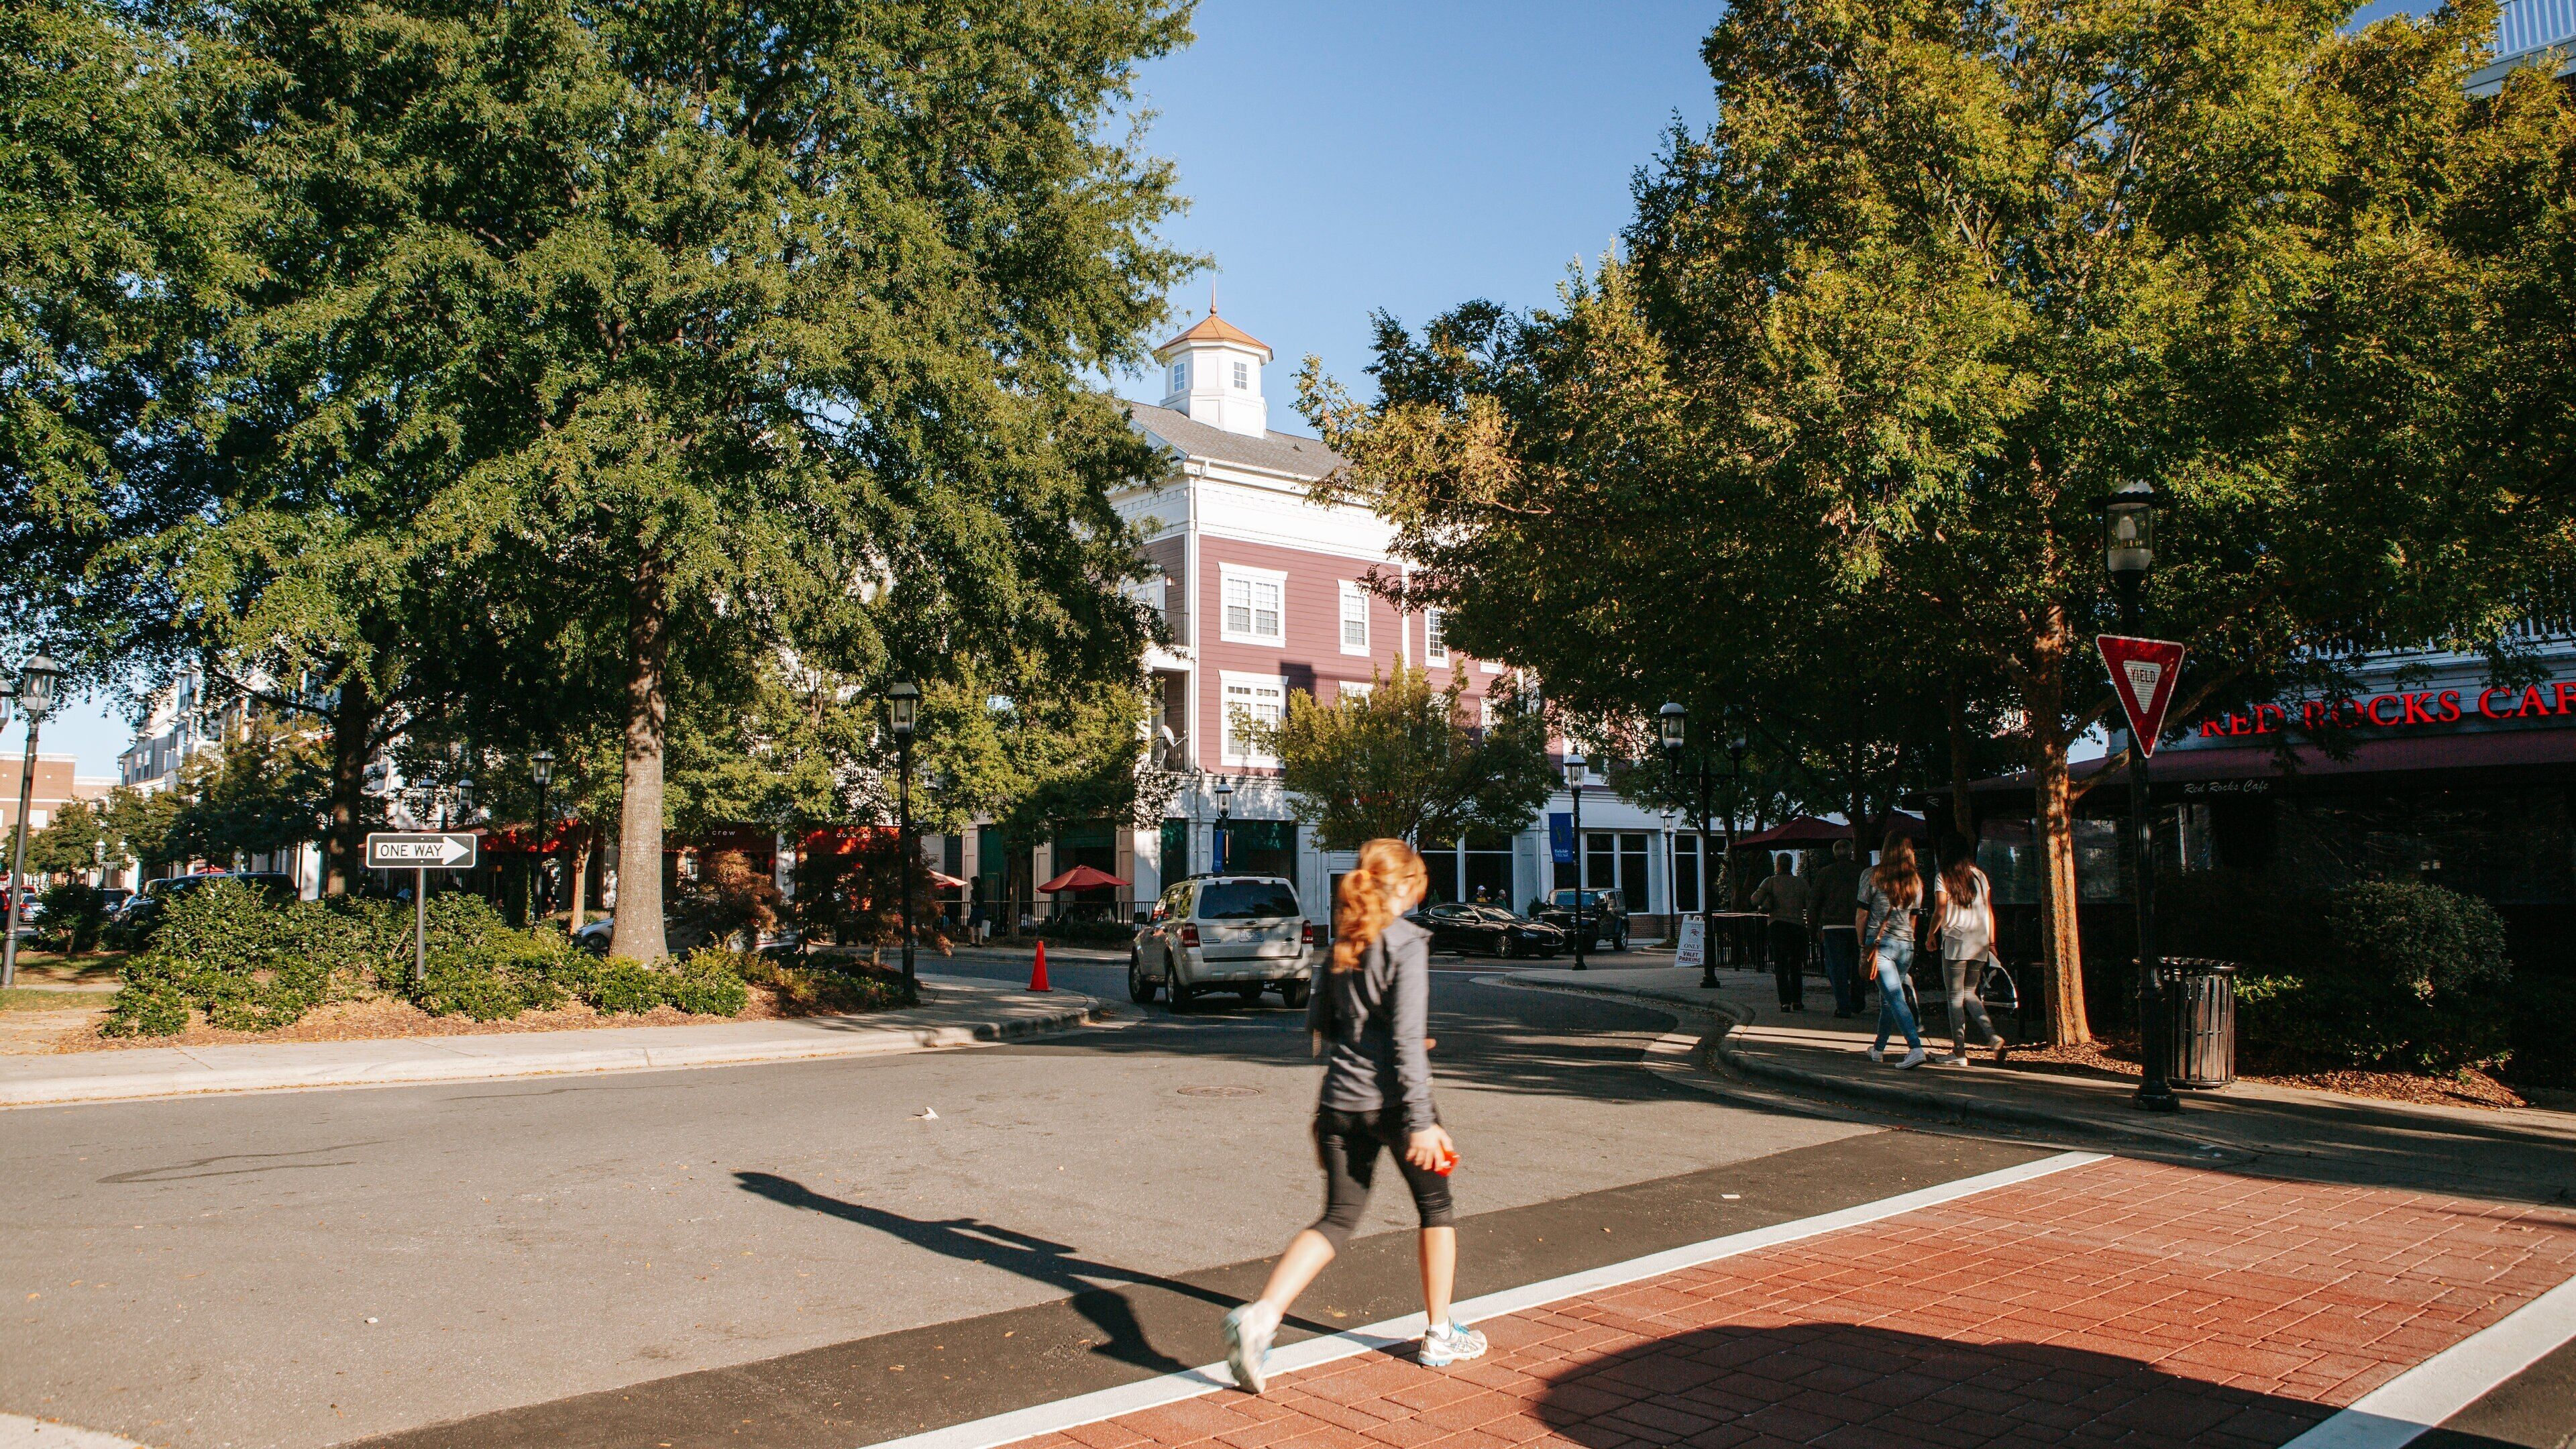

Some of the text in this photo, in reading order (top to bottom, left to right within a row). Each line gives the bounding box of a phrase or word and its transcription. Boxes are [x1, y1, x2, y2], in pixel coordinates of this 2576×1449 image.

[2131, 669, 2155, 683] YIELD
[2184, 780, 2269, 794] Red Rocks Cafe
[380, 845, 443, 857] ONE WAY
